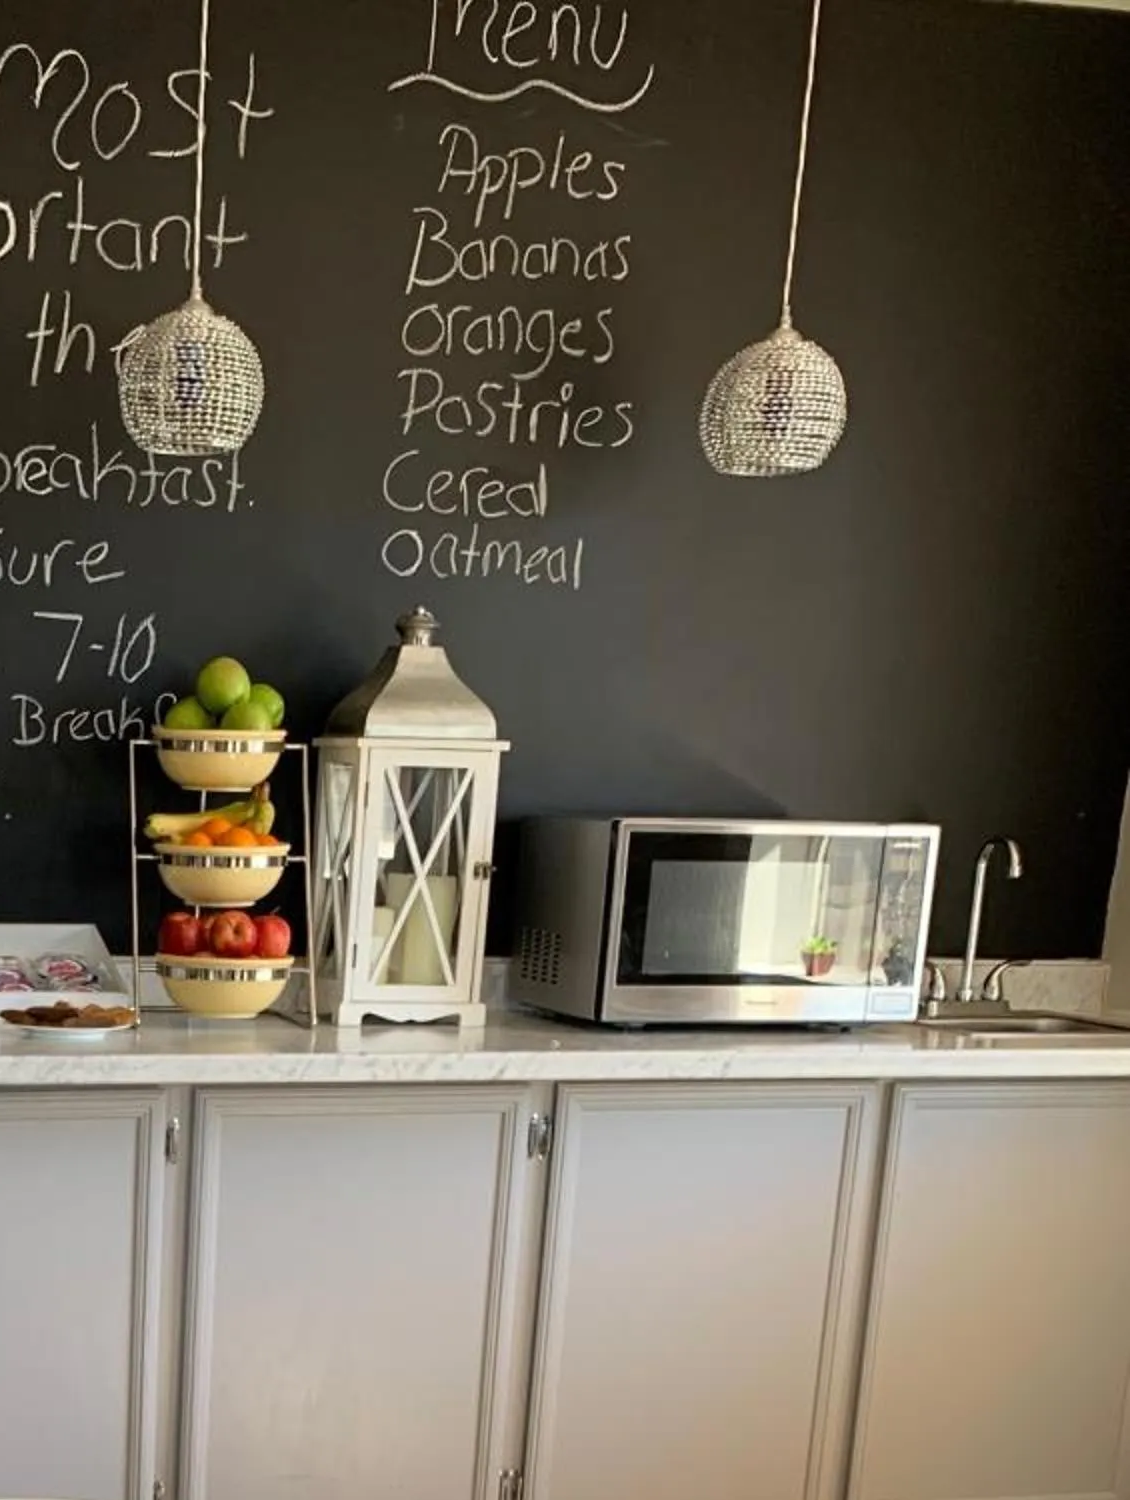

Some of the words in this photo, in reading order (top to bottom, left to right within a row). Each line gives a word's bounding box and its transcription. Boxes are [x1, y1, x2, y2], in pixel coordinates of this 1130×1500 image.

[437, 123, 626, 229] Apples
[405, 206, 631, 296] Bananas
[396, 367, 634, 448] Pastries
[381, 449, 547, 518] Cereal
[32, 610, 157, 683] 7-10
